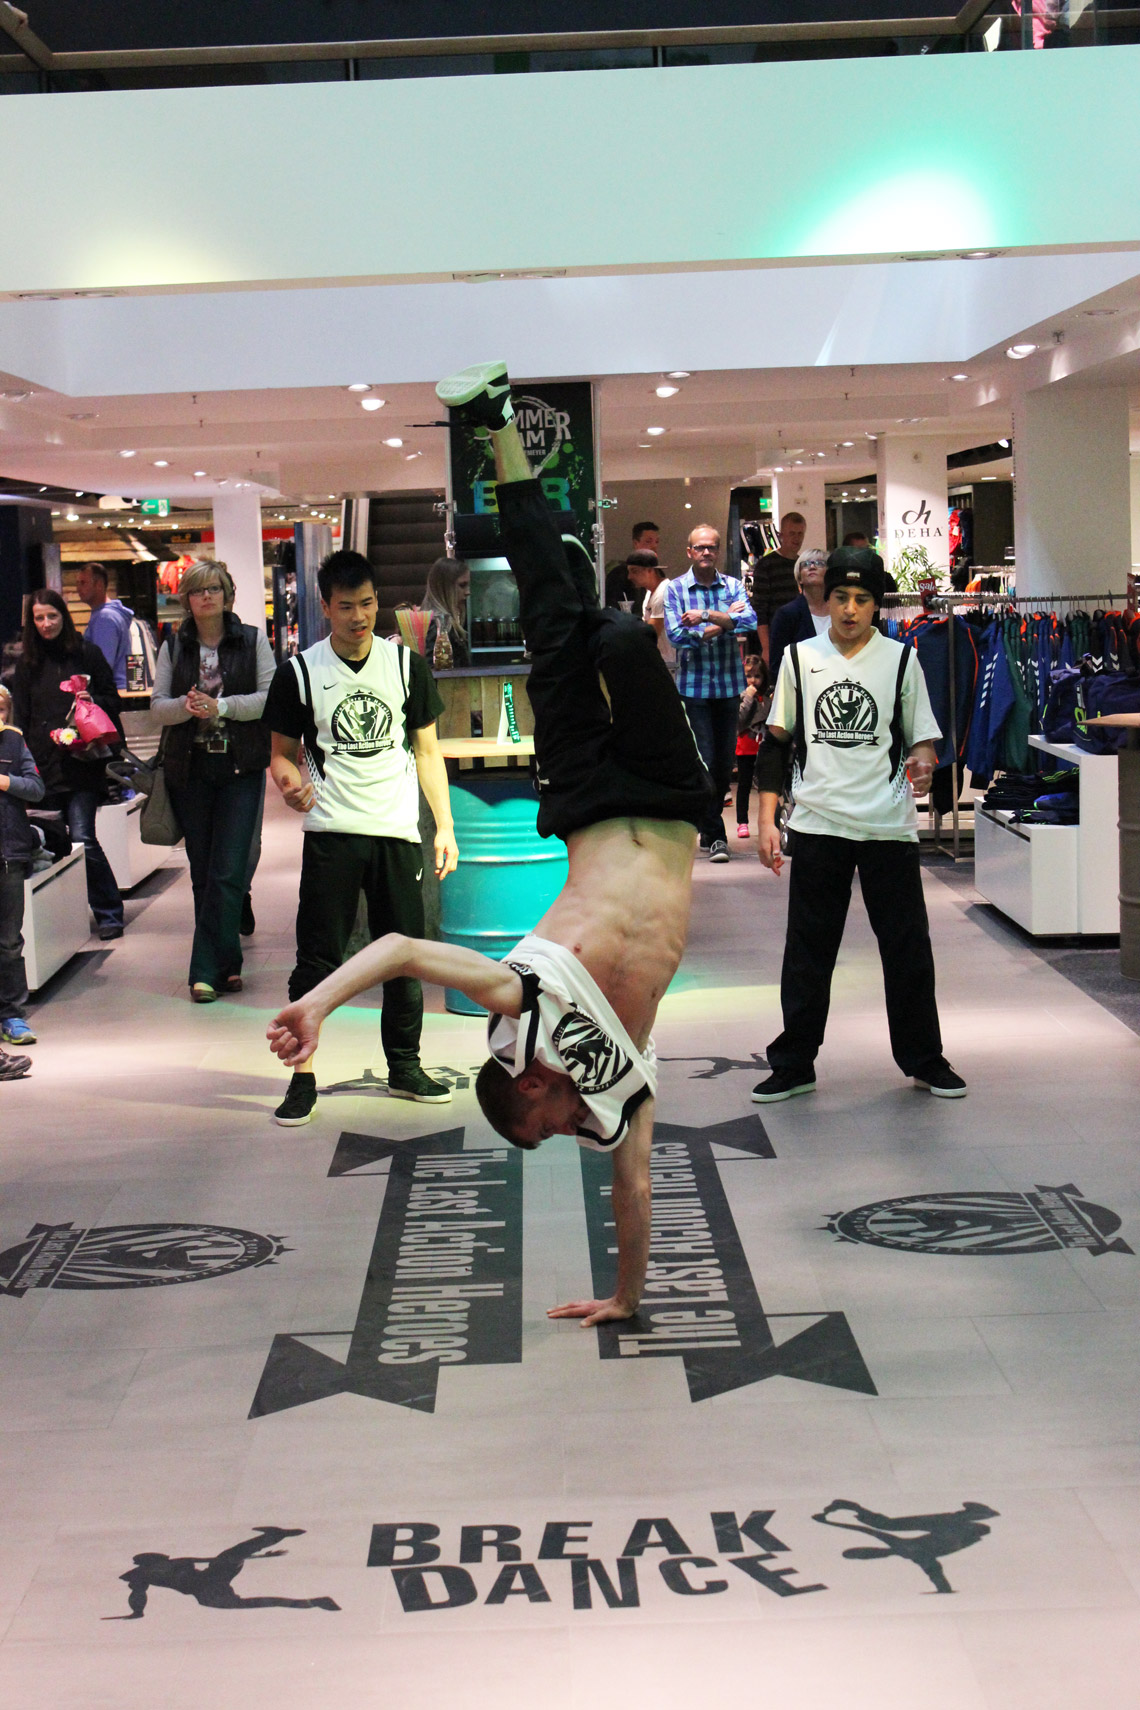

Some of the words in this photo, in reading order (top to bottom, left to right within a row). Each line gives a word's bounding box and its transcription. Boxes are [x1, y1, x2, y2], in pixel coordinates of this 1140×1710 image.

[514, 407, 572, 440] MMER
[474, 477, 572, 514] BR
[894, 527, 943, 539] DEHA
[826, 730, 837, 739] Last
[837, 731, 854, 740] Action
[854, 731, 874, 741] Heroes
[413, 1149, 508, 1178] The
[404, 1180, 507, 1217] Last
[395, 1220, 506, 1279] Action
[639, 1258, 730, 1304] Last
[377, 1283, 504, 1365] Heroes
[617, 1309, 742, 1356] The
[366, 1510, 792, 1567] BREAK
[391, 1552, 829, 1613] DANCE
